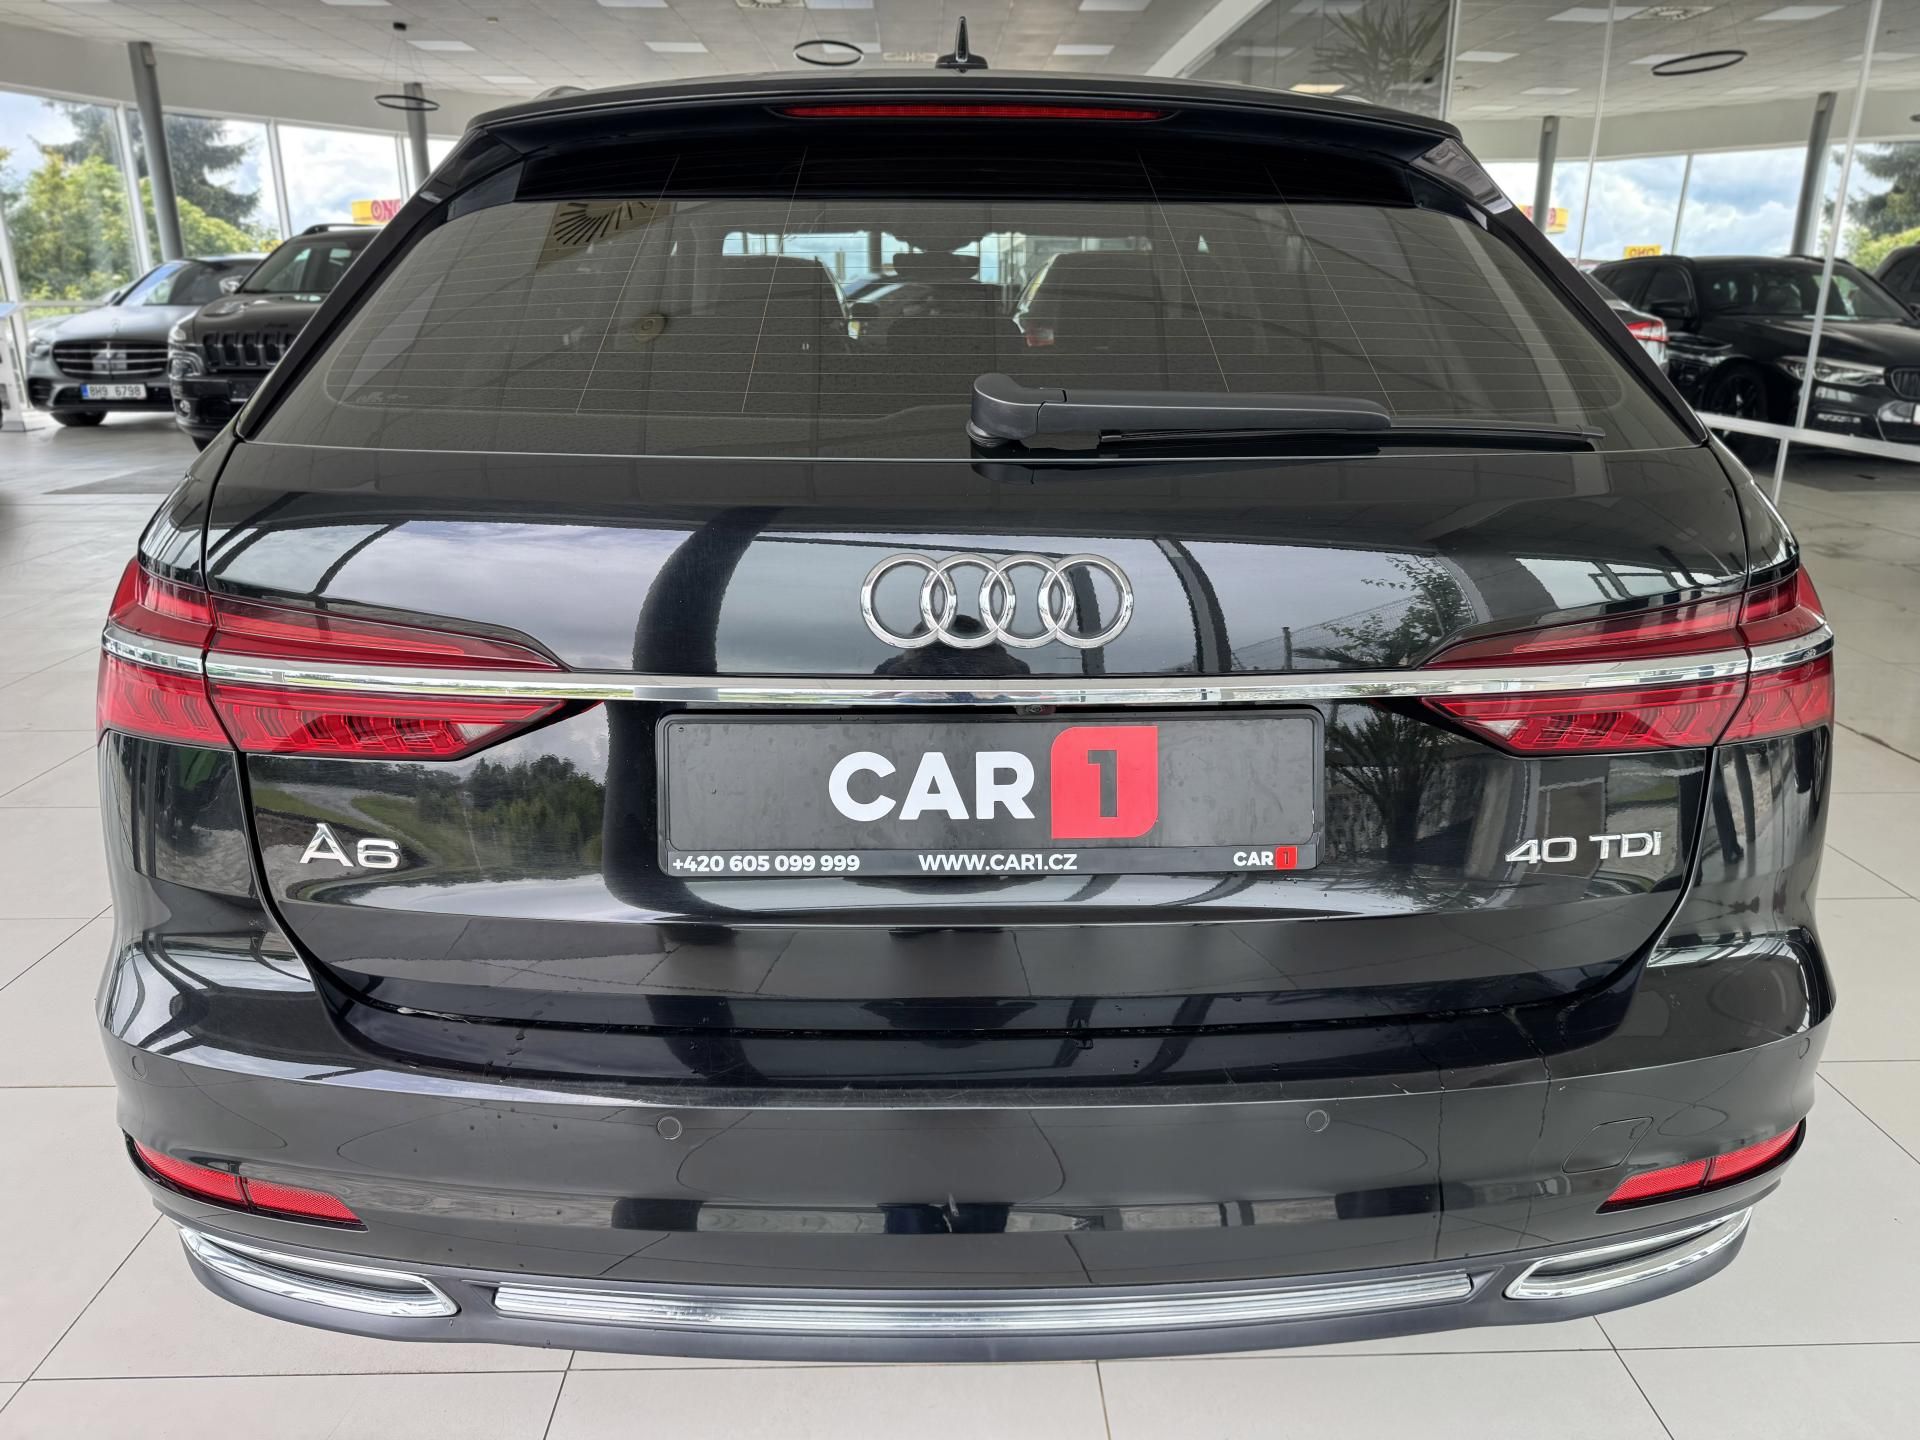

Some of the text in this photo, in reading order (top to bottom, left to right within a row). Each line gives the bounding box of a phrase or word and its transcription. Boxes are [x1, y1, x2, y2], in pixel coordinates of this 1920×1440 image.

[299, 822, 400, 869] A6
[1504, 830, 1662, 864] 40 TDI
[672, 854, 860, 872] +420 605 099 999
[918, 853, 1078, 871] WWW.CAR1.CZ
